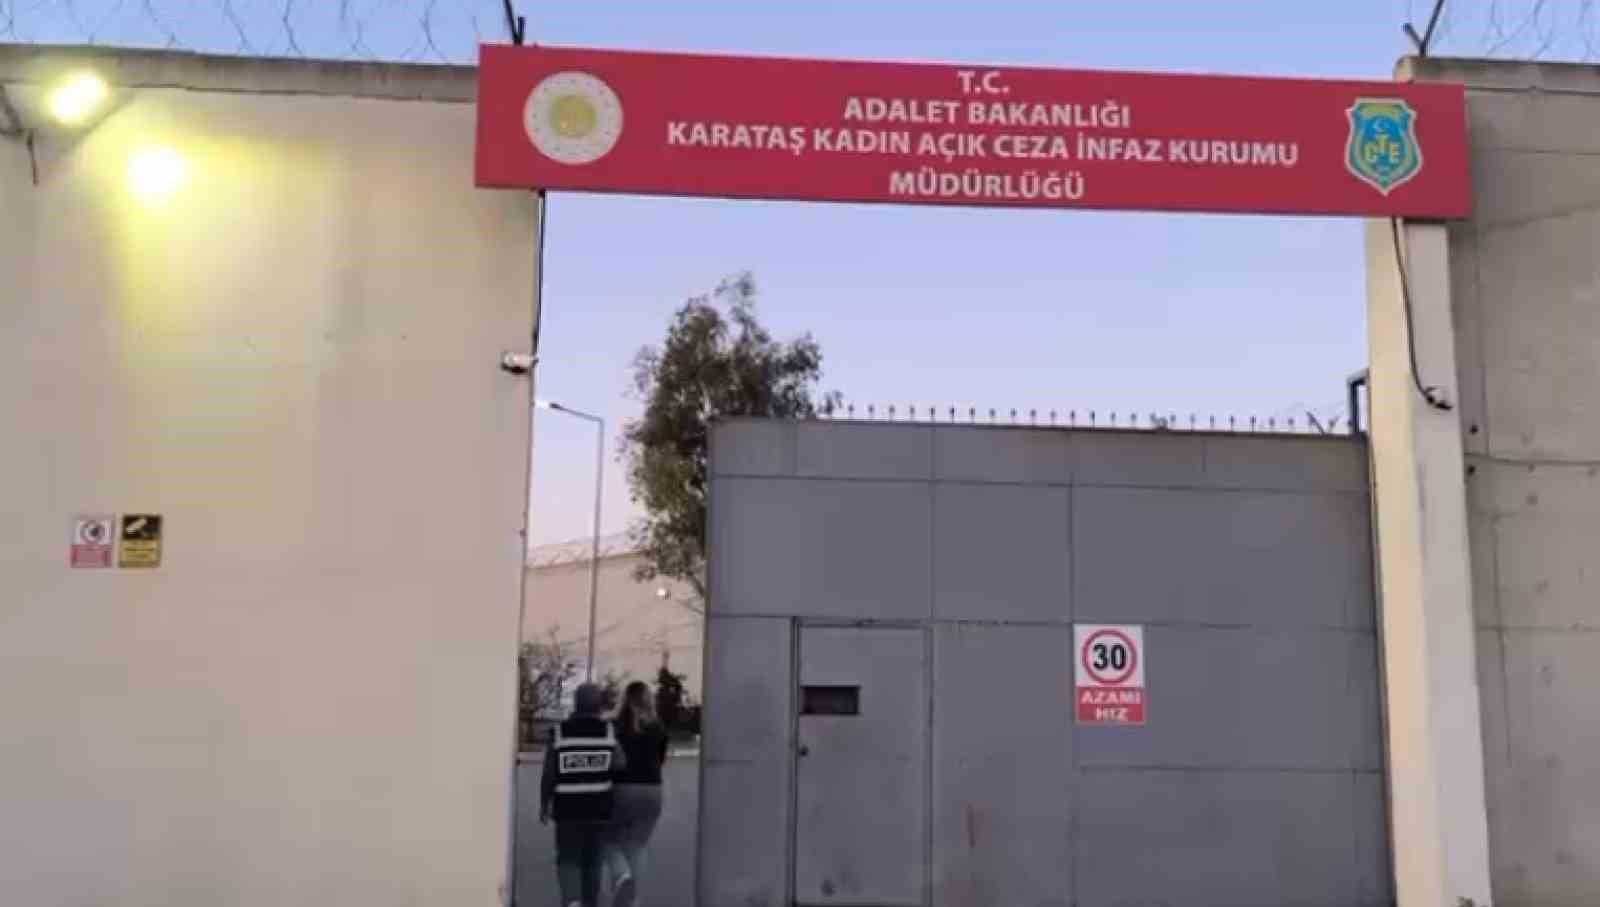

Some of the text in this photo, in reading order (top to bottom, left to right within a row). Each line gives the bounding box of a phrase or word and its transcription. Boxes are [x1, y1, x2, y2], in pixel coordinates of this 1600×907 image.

[957, 71, 1010, 94] T.C.
[843, 97, 1131, 128] ADALET BAKANLIĞI
[667, 121, 1299, 166] KARATAŞ KADIN AÇIK CEZA İNFAZ KURUMU
[889, 167, 1085, 199] MÜDÜRLÜĞÜ
[1093, 644, 1126, 670] 30
